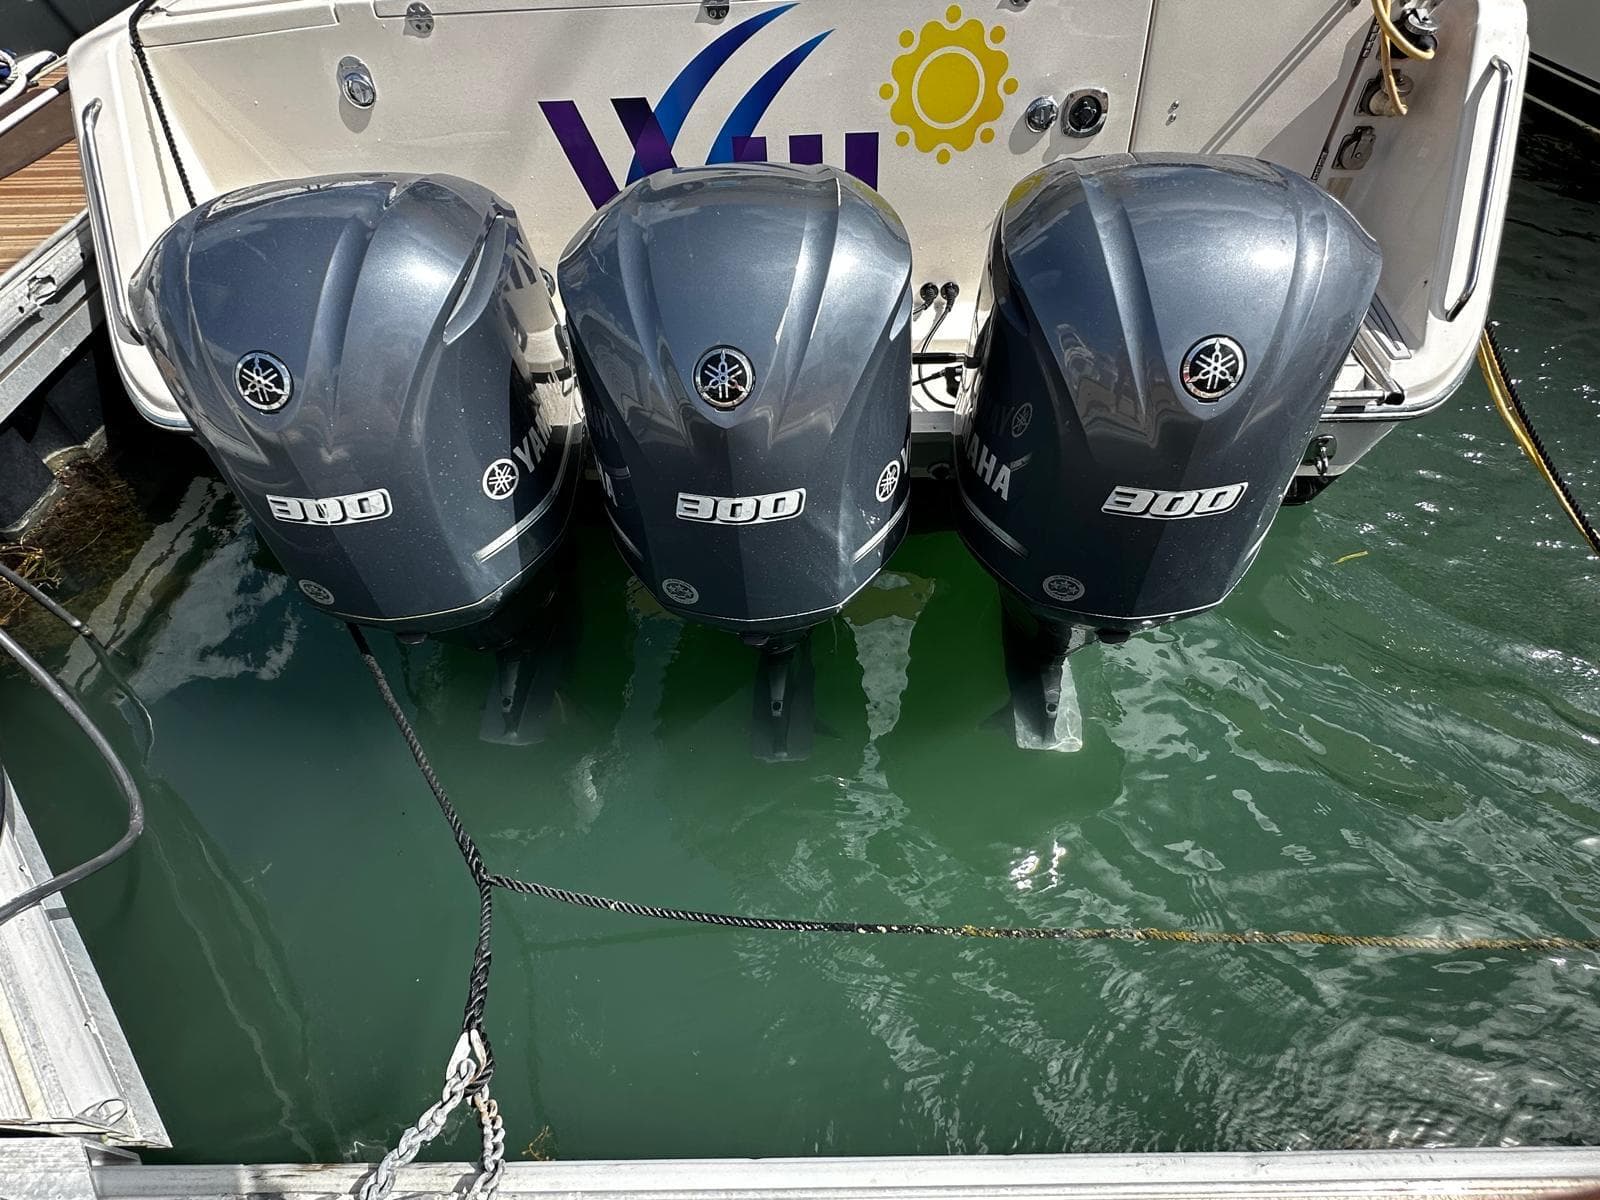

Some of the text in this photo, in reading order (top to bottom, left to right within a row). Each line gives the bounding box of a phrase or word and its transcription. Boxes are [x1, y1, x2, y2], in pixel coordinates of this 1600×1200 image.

[964, 430, 1011, 502] AHA
[266, 488, 393, 526] 300
[676, 488, 807, 526] 300
[1101, 481, 1249, 520] 300
